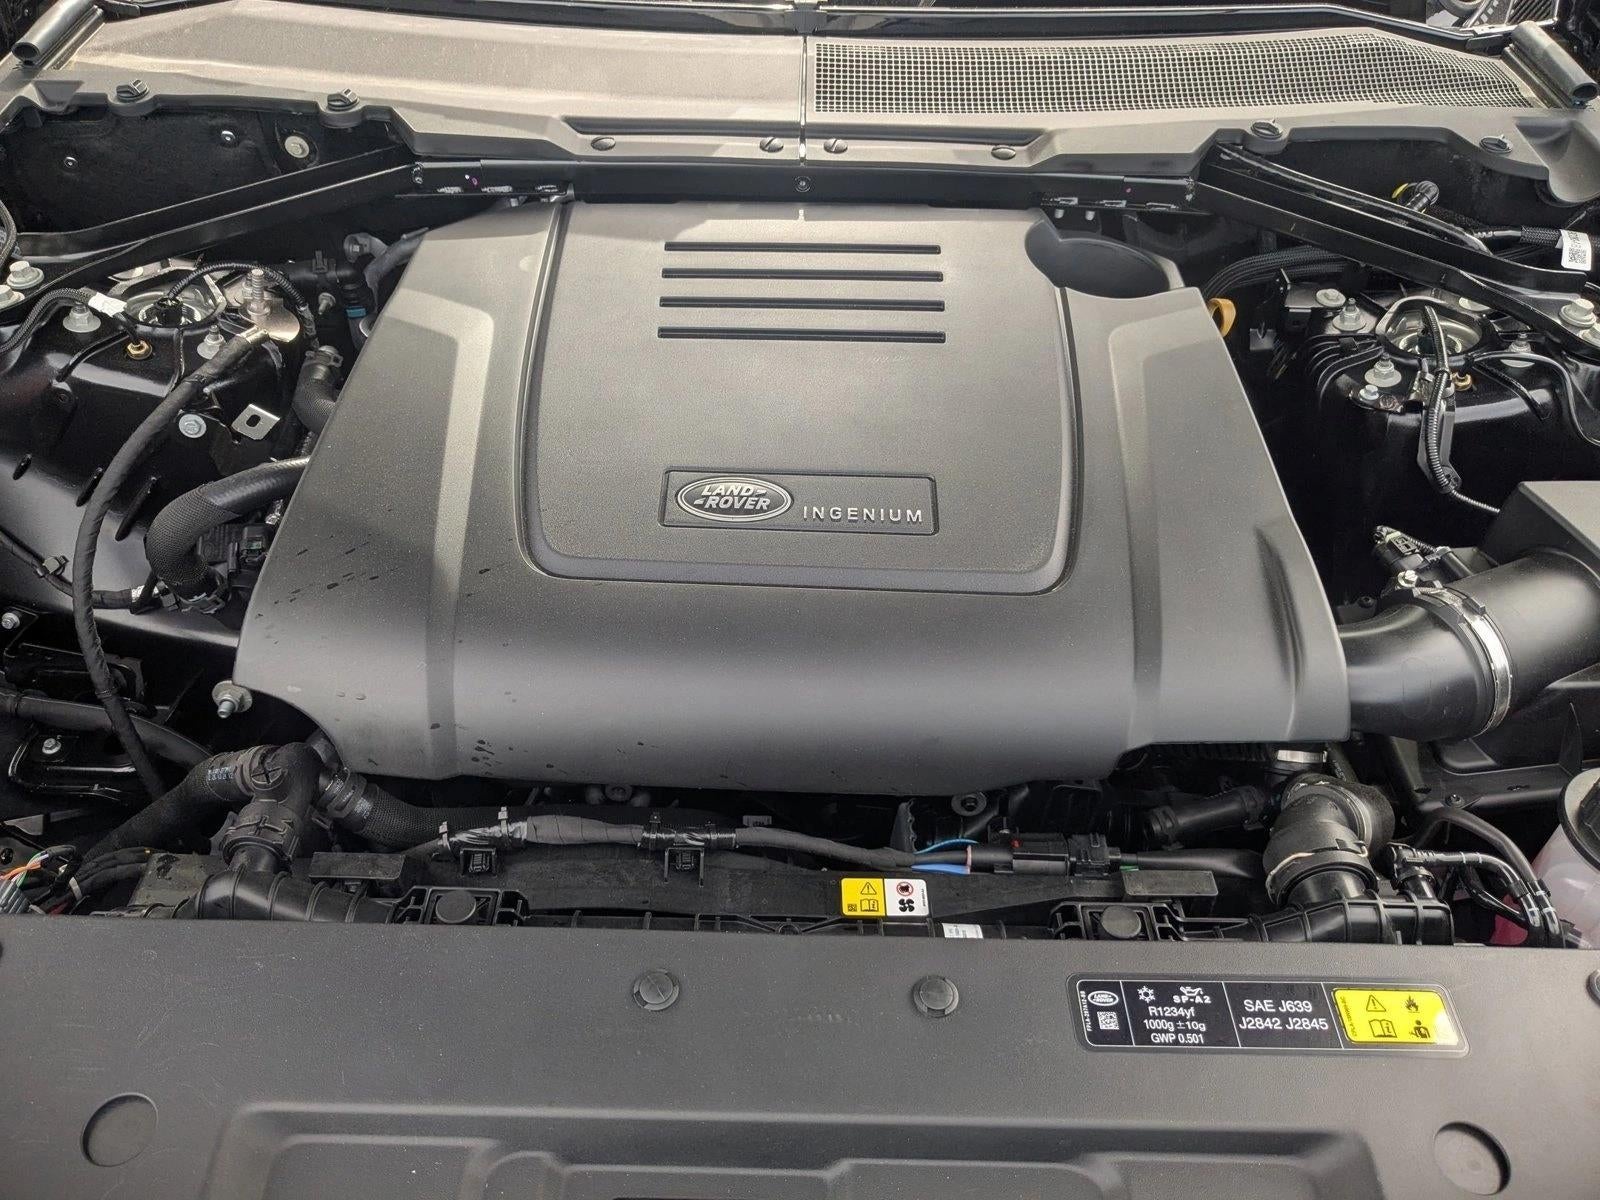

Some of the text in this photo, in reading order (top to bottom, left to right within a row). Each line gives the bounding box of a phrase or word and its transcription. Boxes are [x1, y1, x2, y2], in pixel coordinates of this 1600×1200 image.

[701, 482, 756, 497] LAND
[704, 497, 771, 510] ROVER
[802, 505, 923, 522] INGENIUM
[1172, 995, 1212, 1004] SP-A2
[1243, 999, 1313, 1013] SAE J639
[1148, 1006, 1196, 1019] R1234yf
[1143, 1019, 1175, 1031] 1000g
[1238, 1017, 1329, 1030] J2842 J2845
[1150, 1033, 1205, 1044] GWP 0.501
